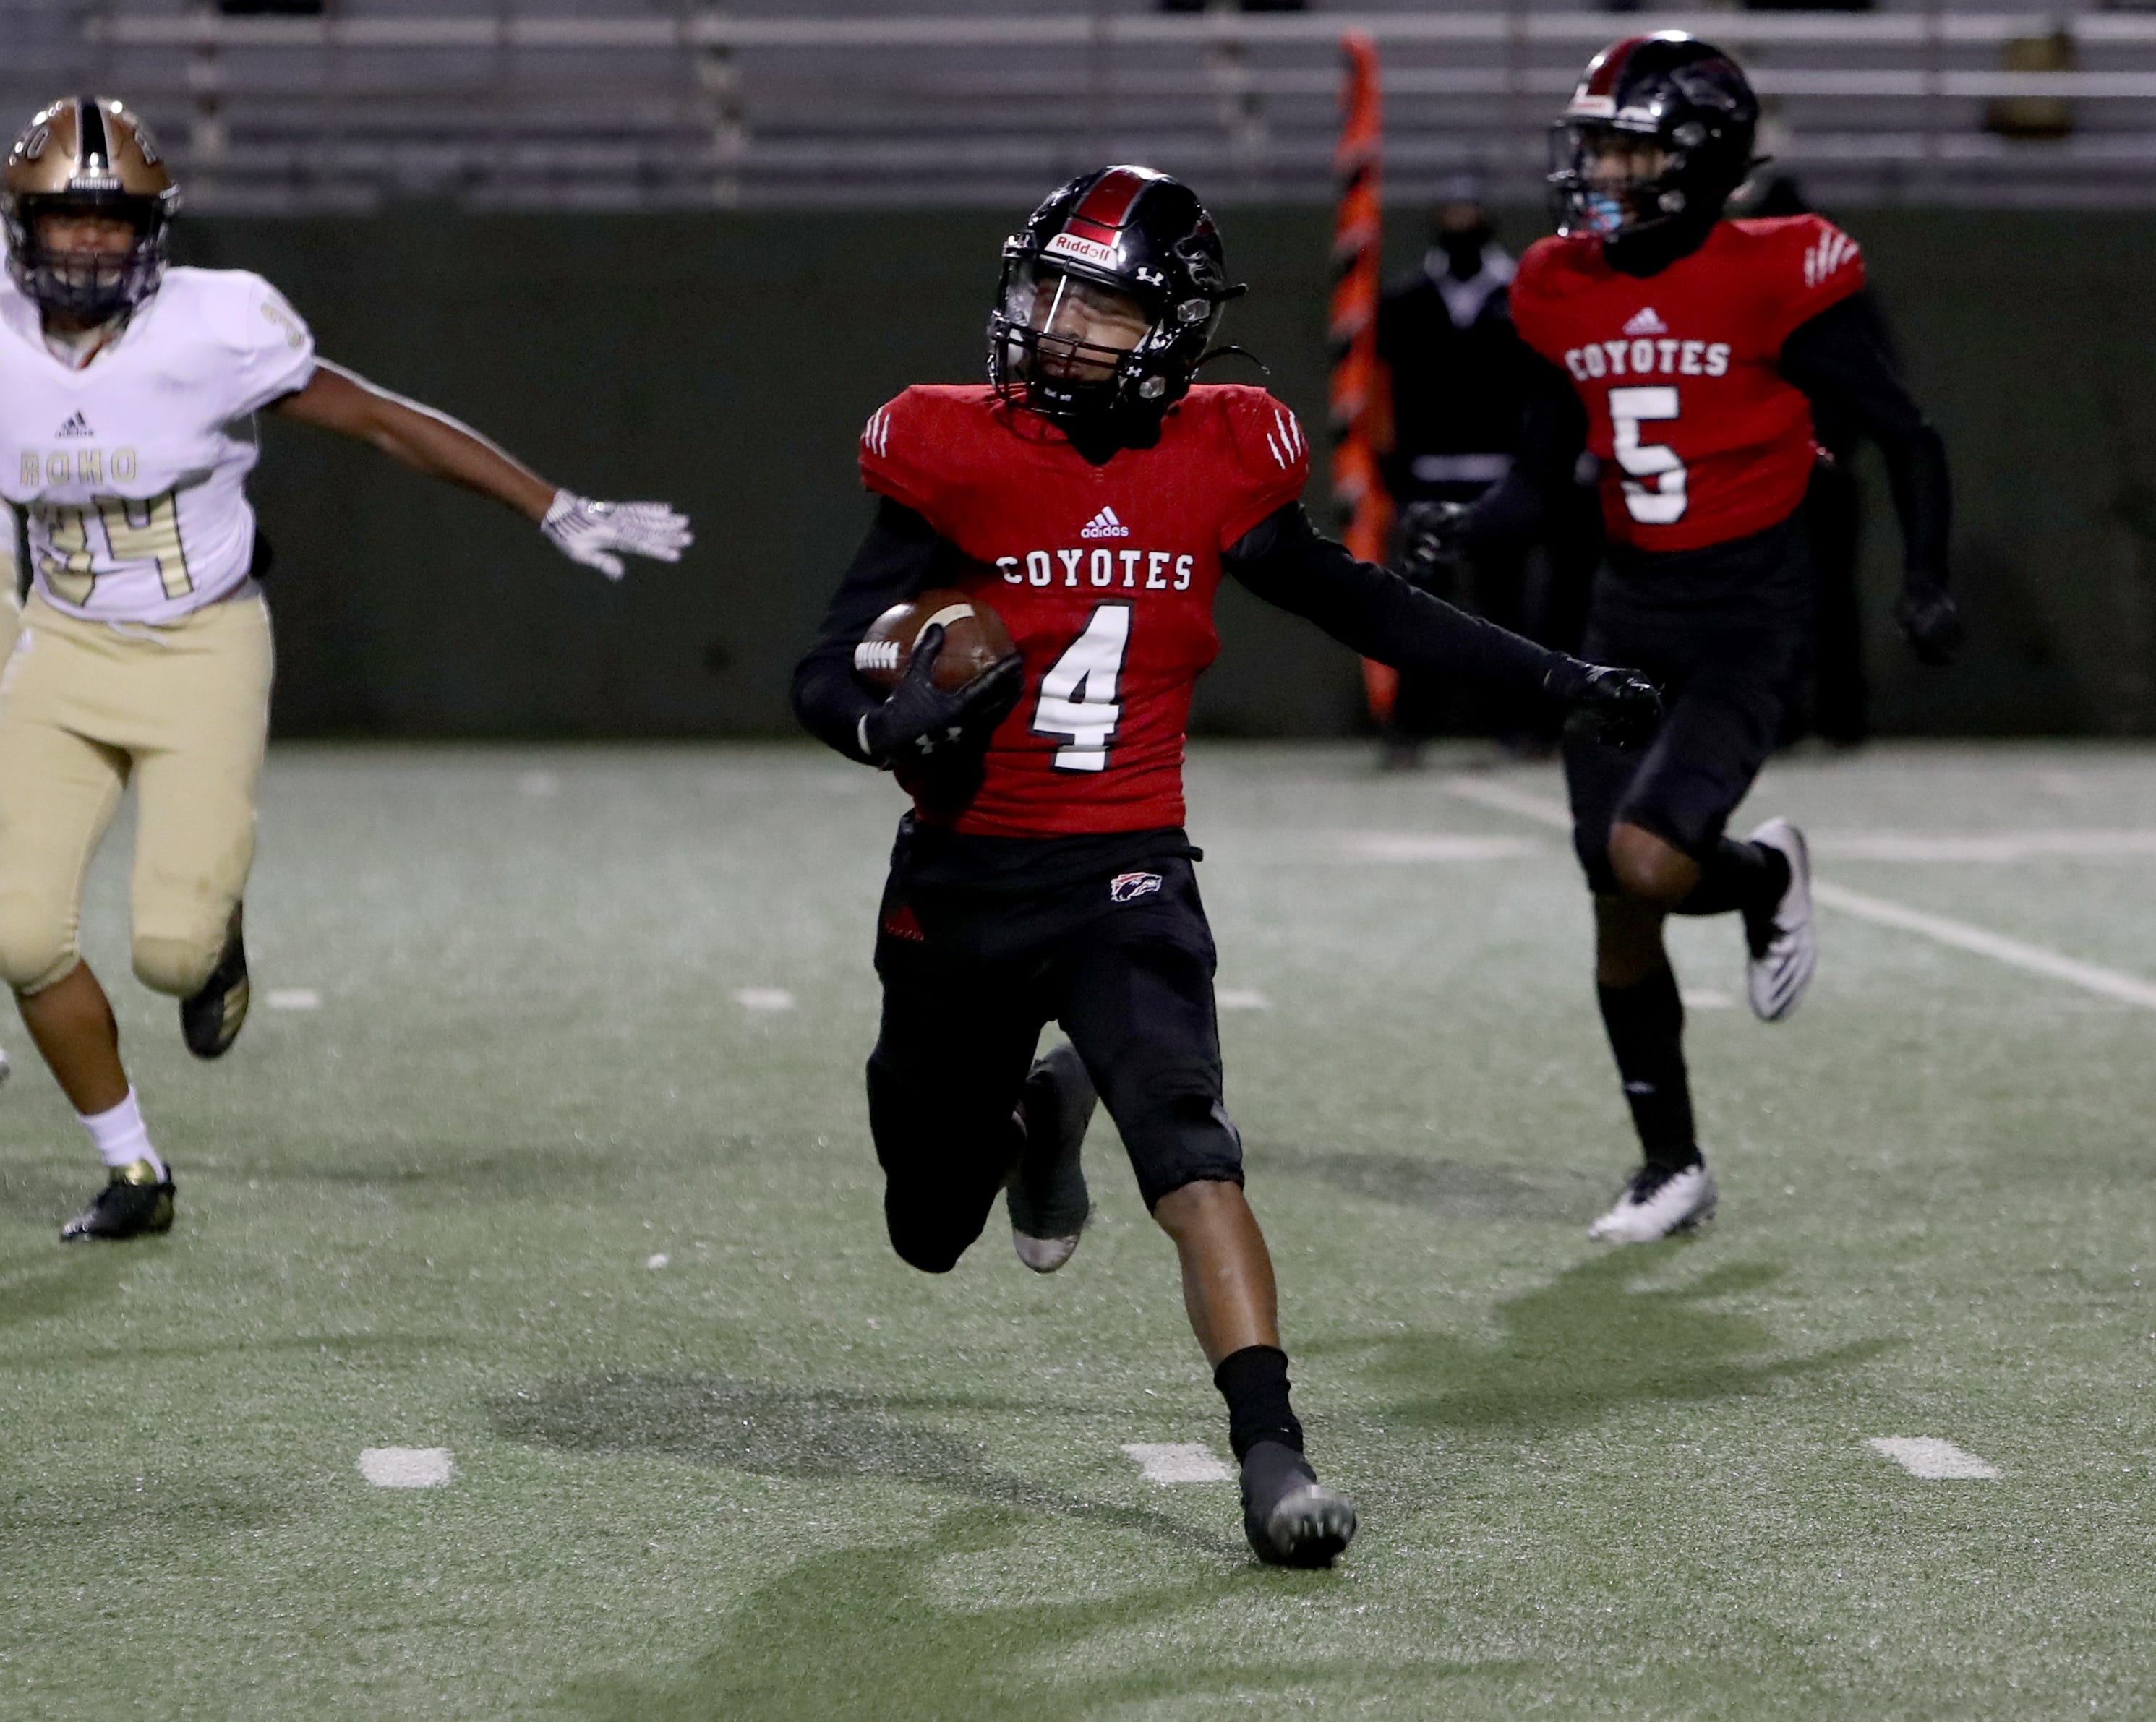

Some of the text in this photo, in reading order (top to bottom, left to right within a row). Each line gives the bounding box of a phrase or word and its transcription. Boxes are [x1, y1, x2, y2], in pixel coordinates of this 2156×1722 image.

[1565, 338, 1731, 382] COYOTES
[1607, 385, 1689, 525] 5
[1080, 525, 1129, 539] adidas
[995, 548, 1194, 591] COYOTES
[1029, 599, 1133, 772] 4
